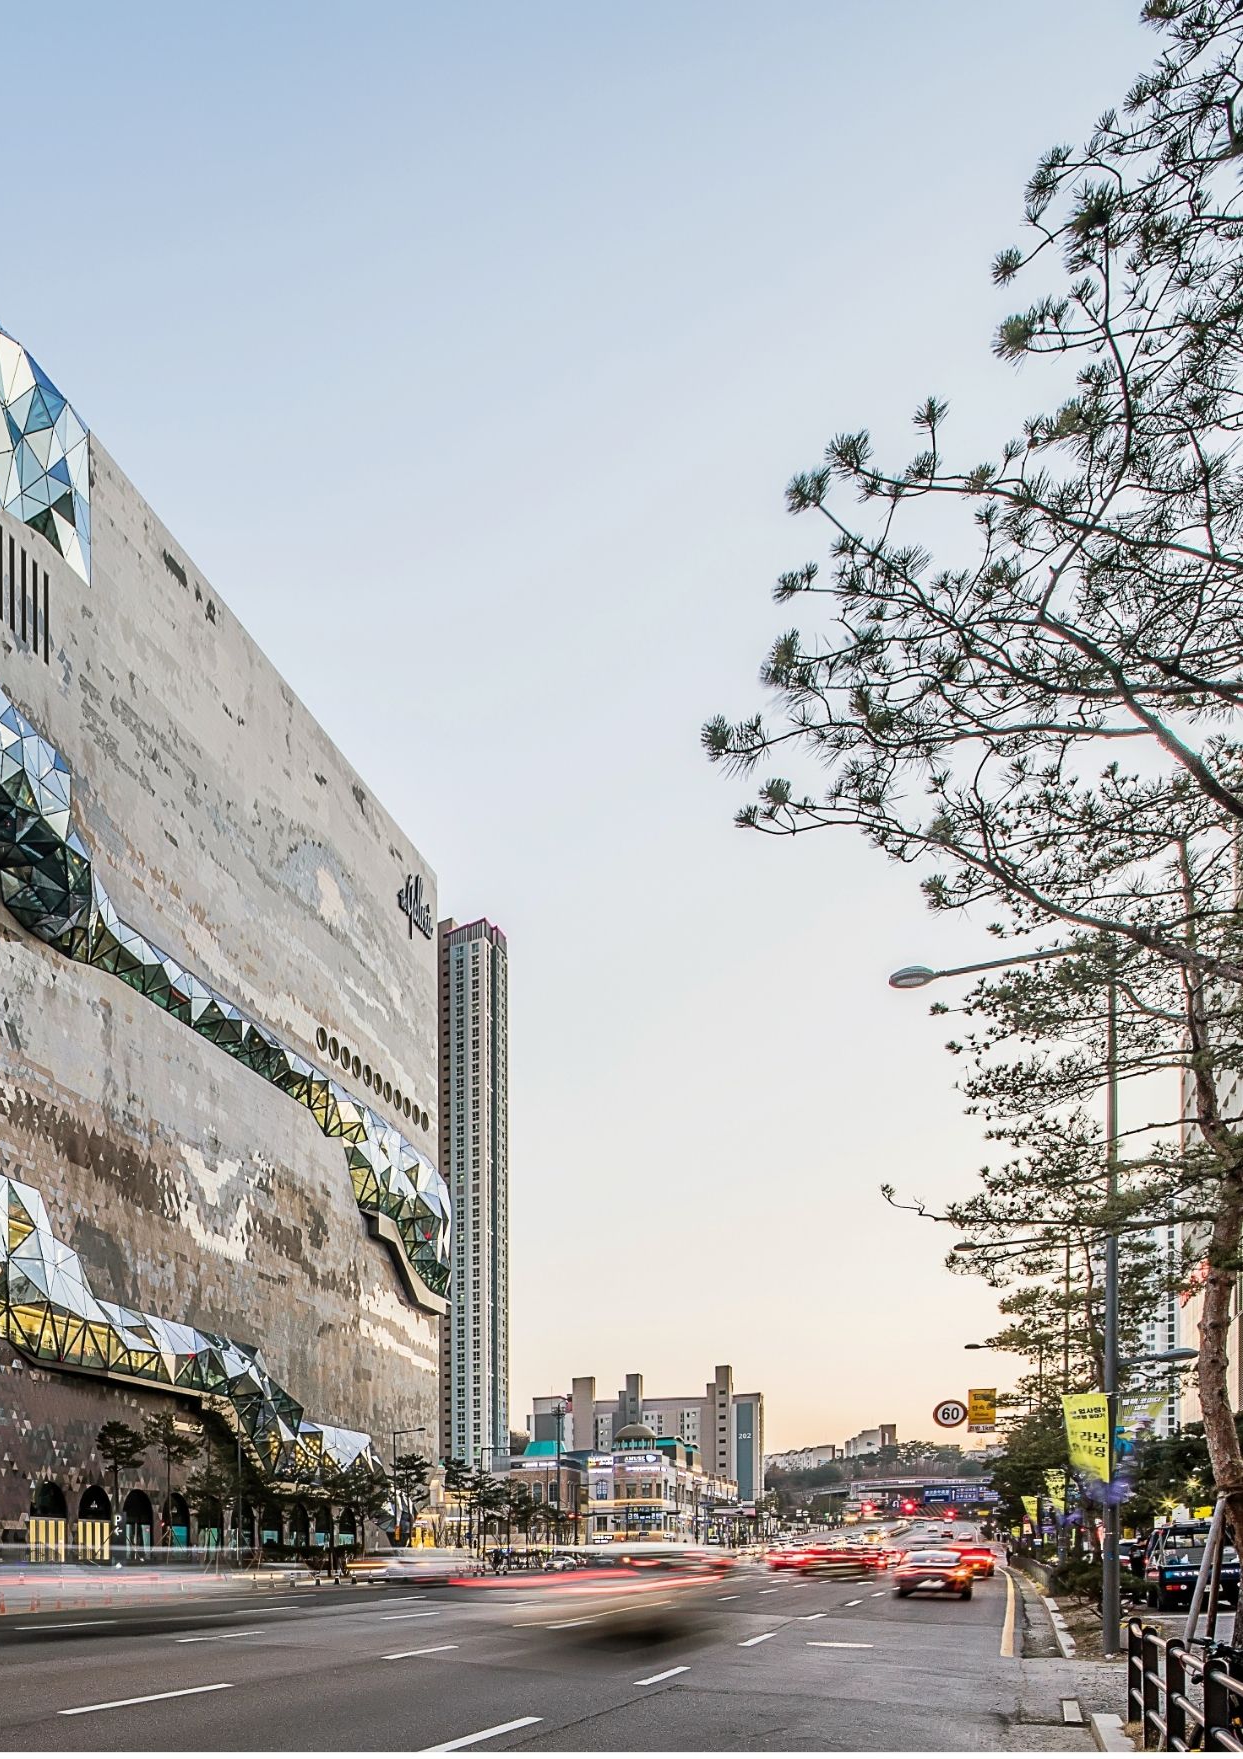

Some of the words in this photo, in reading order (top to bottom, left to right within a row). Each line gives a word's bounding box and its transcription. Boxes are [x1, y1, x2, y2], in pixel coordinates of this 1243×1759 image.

[942, 1407, 960, 1420] 60
[738, 1432, 752, 1440] 202
[115, 1514, 122, 1526] P
